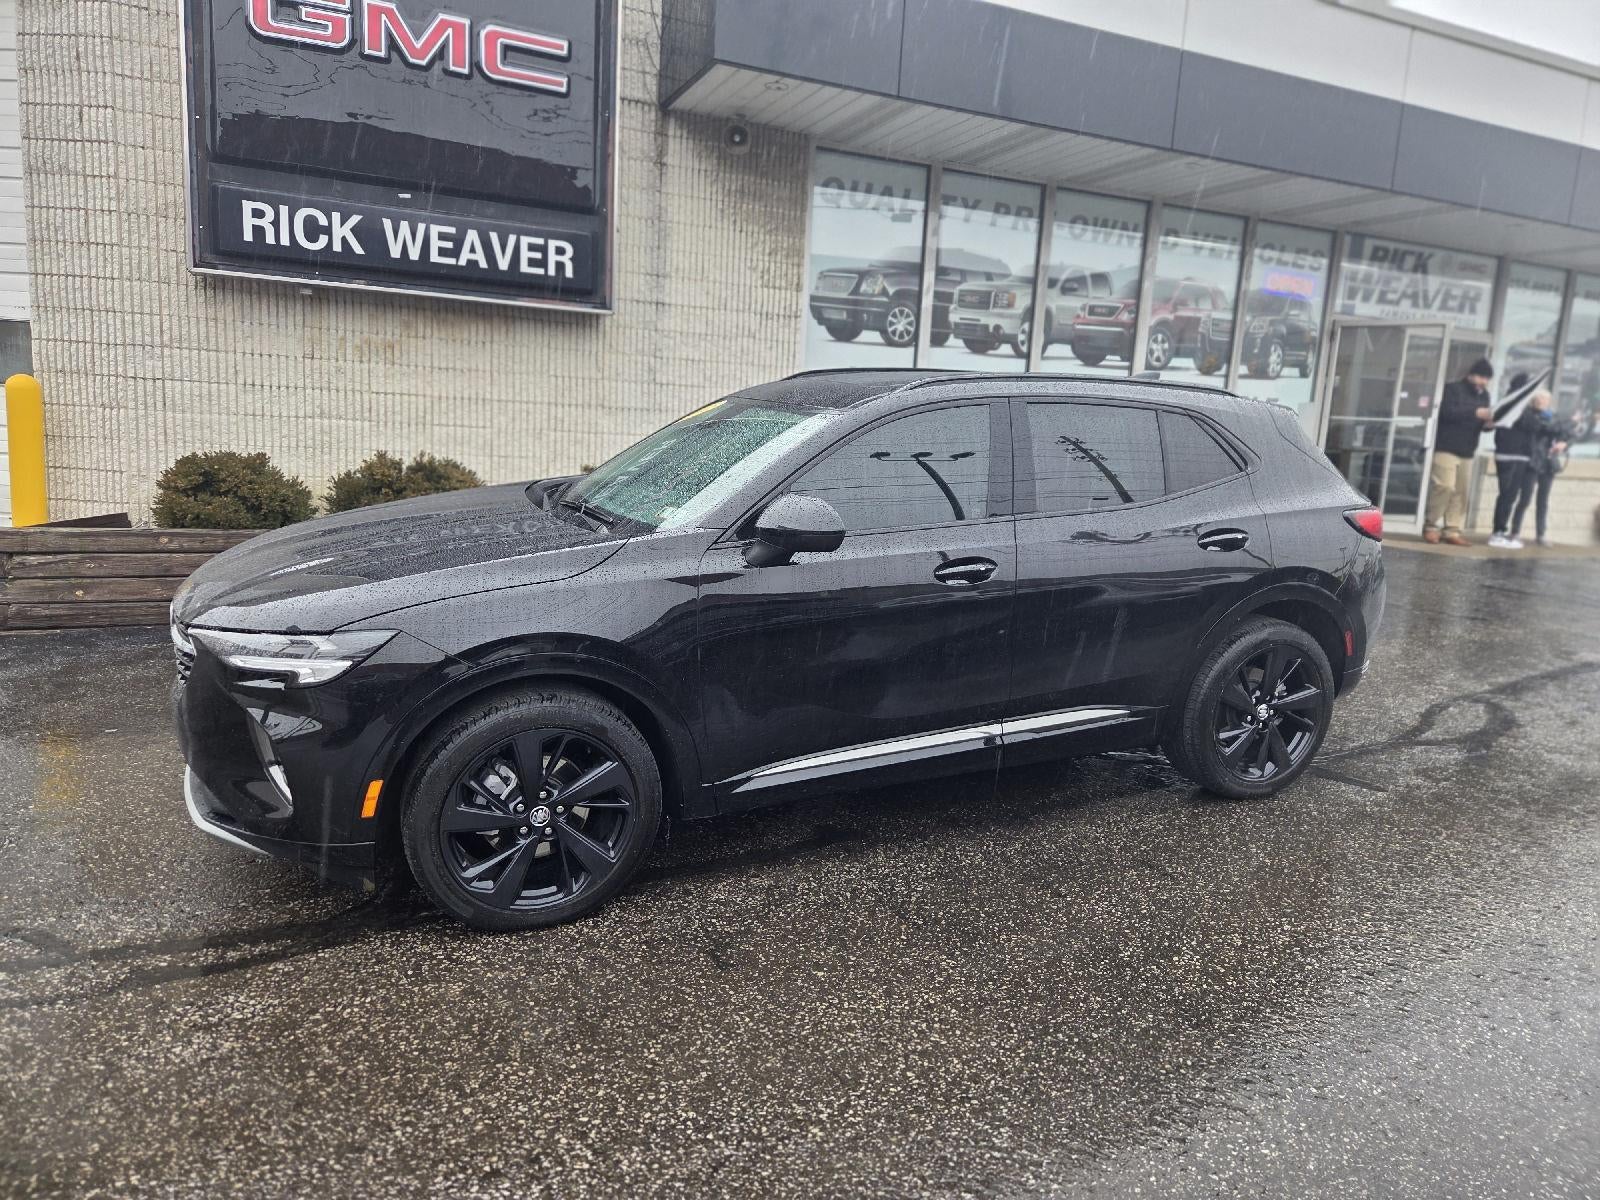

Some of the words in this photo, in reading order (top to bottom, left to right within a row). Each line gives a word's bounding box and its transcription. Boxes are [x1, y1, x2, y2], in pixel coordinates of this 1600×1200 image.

[247, 0, 570, 94] GMC
[242, 199, 365, 255] RICK
[382, 217, 575, 279] WEAVER
[821, 177, 982, 223] QUALTY
